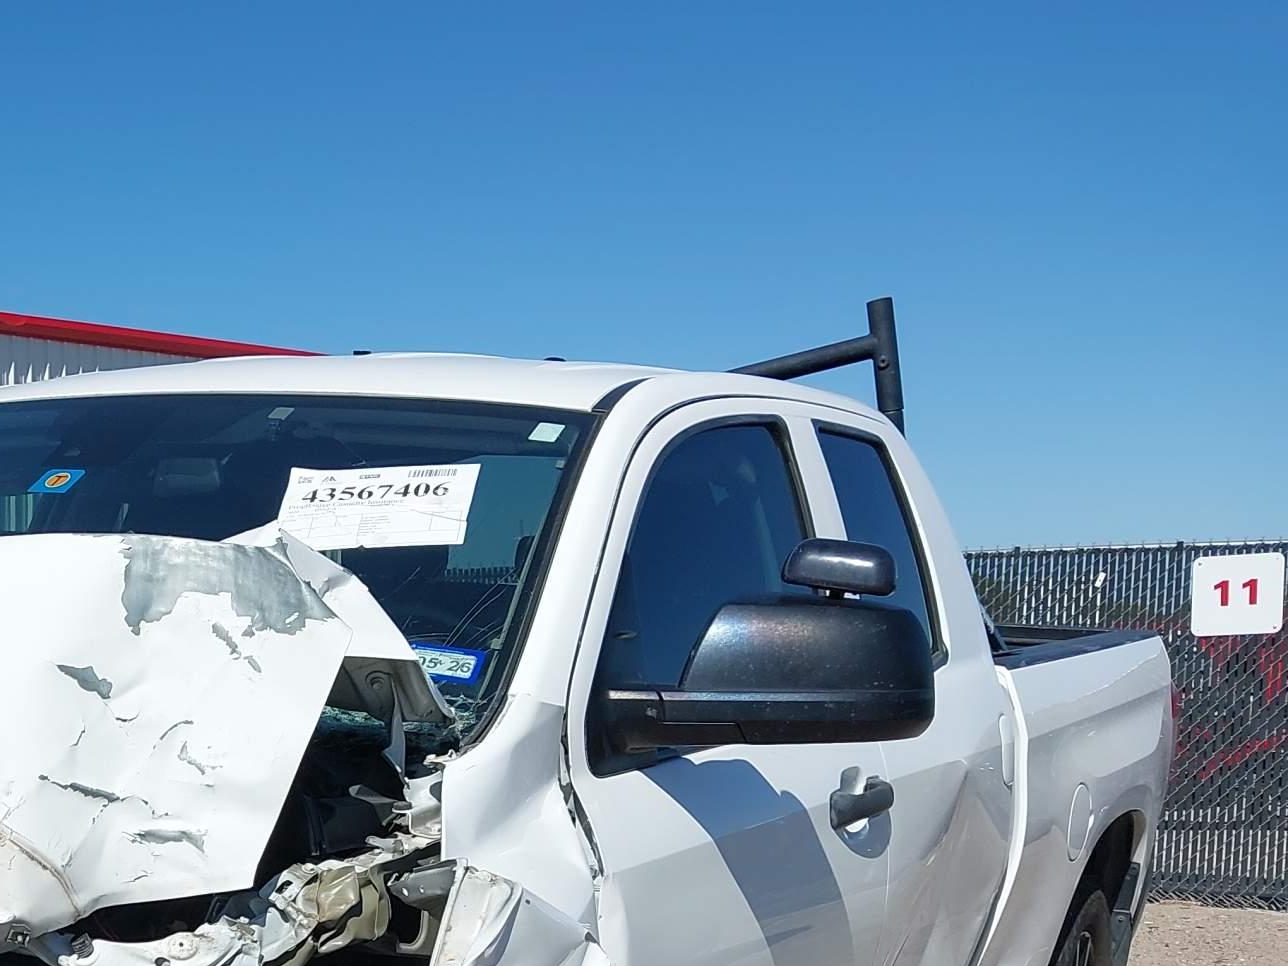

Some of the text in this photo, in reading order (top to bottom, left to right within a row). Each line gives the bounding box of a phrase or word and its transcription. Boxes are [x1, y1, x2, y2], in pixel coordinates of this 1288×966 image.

[301, 481, 450, 503] 43567406
[1213, 578, 1259, 607] 11
[447, 660, 472, 674] 26
